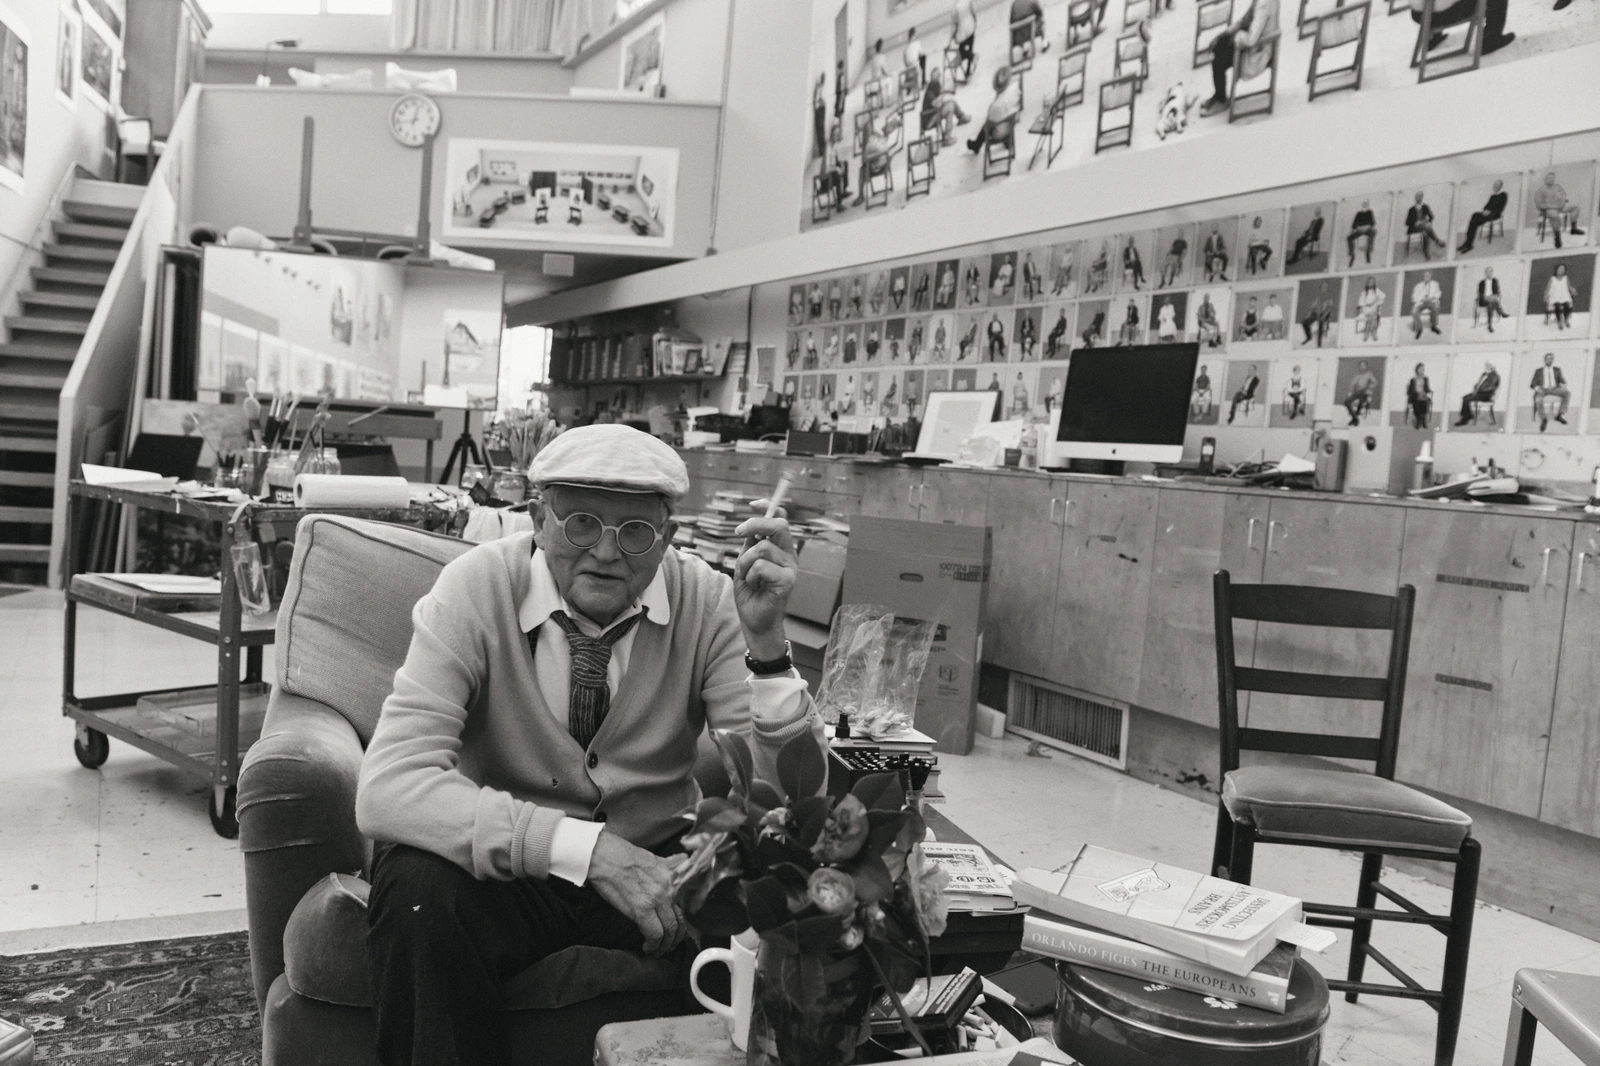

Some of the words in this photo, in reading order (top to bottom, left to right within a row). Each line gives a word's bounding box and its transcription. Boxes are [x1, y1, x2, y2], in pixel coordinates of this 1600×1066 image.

[1187, 892, 1223, 915] BRAINS
[1222, 897, 1271, 930] DISSECTING
[1031, 932, 1097, 957] ORLANDO
[1101, 950, 1138, 968] FIGES
[1142, 959, 1170, 976] THE
[1174, 968, 1257, 998] EUROPEANS
